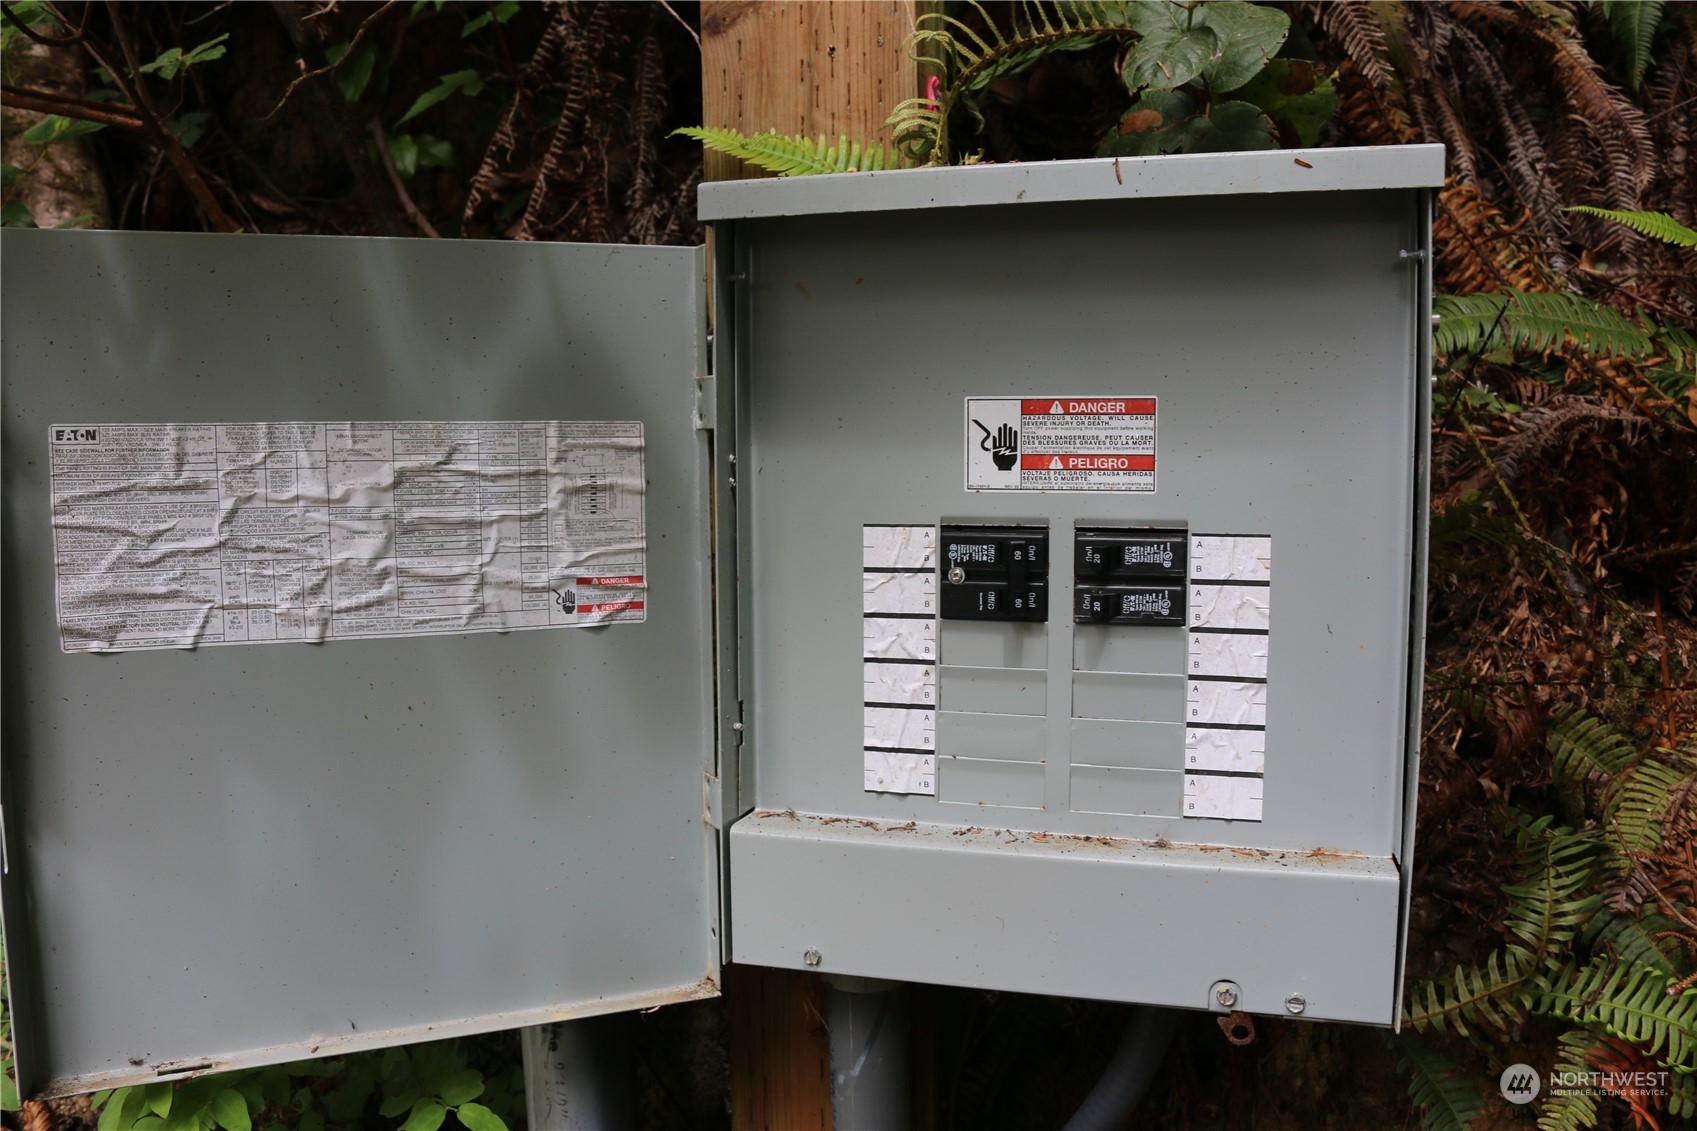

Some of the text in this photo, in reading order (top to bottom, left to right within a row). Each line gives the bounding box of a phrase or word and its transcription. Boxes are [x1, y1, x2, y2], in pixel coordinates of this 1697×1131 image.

[1069, 402, 1125, 413] DANGER
[56, 430, 96, 441] EATON
[1069, 458, 1128, 469] PELIGRO
[924, 555, 930, 563] B
[1014, 551, 1021, 560] 60
[1094, 554, 1100, 563] 20
[601, 603, 631, 611] PELIGRO
[1015, 599, 1022, 608] 60
[1094, 602, 1100, 611] 20
